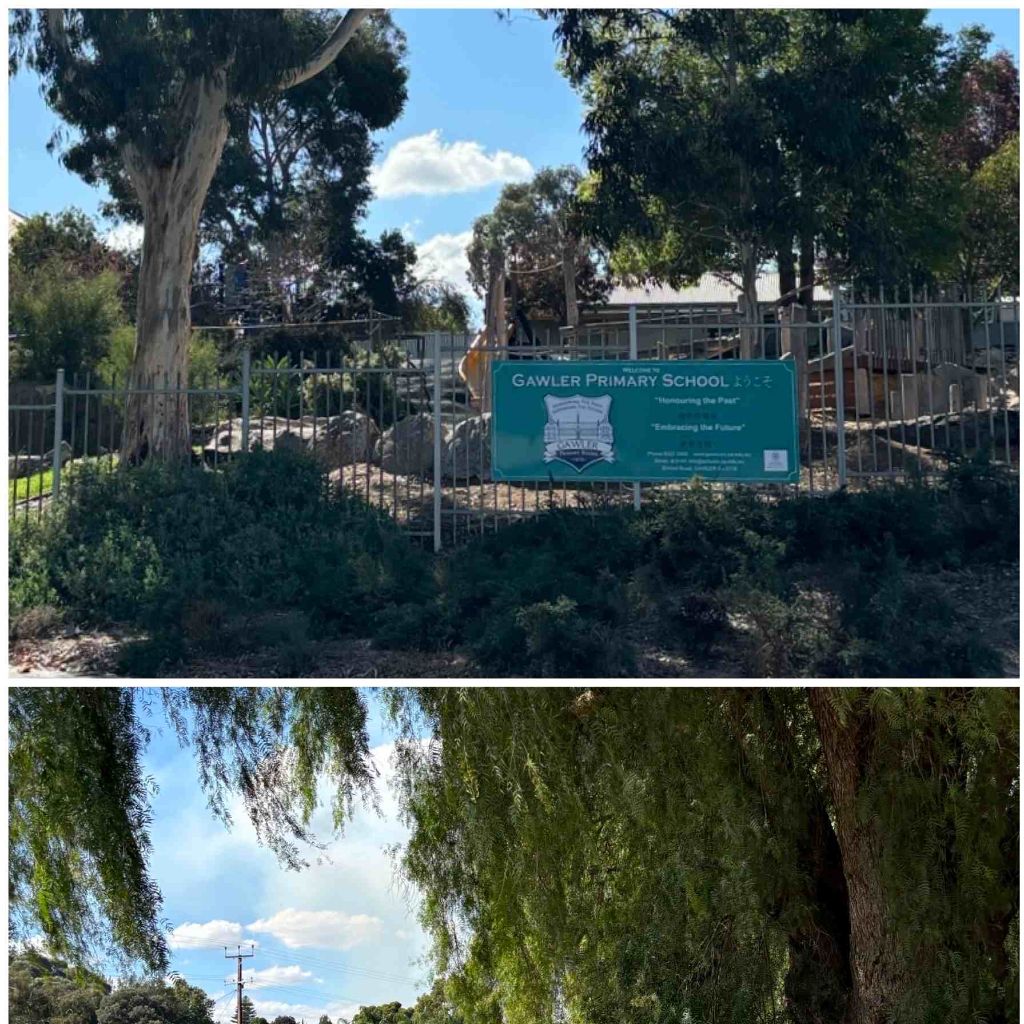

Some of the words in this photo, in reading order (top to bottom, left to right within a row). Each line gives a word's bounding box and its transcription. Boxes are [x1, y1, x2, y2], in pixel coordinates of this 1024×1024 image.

[511, 373, 581, 387] GAWLER
[586, 373, 657, 387] PRIMARY
[662, 373, 730, 387] SCHOOL
